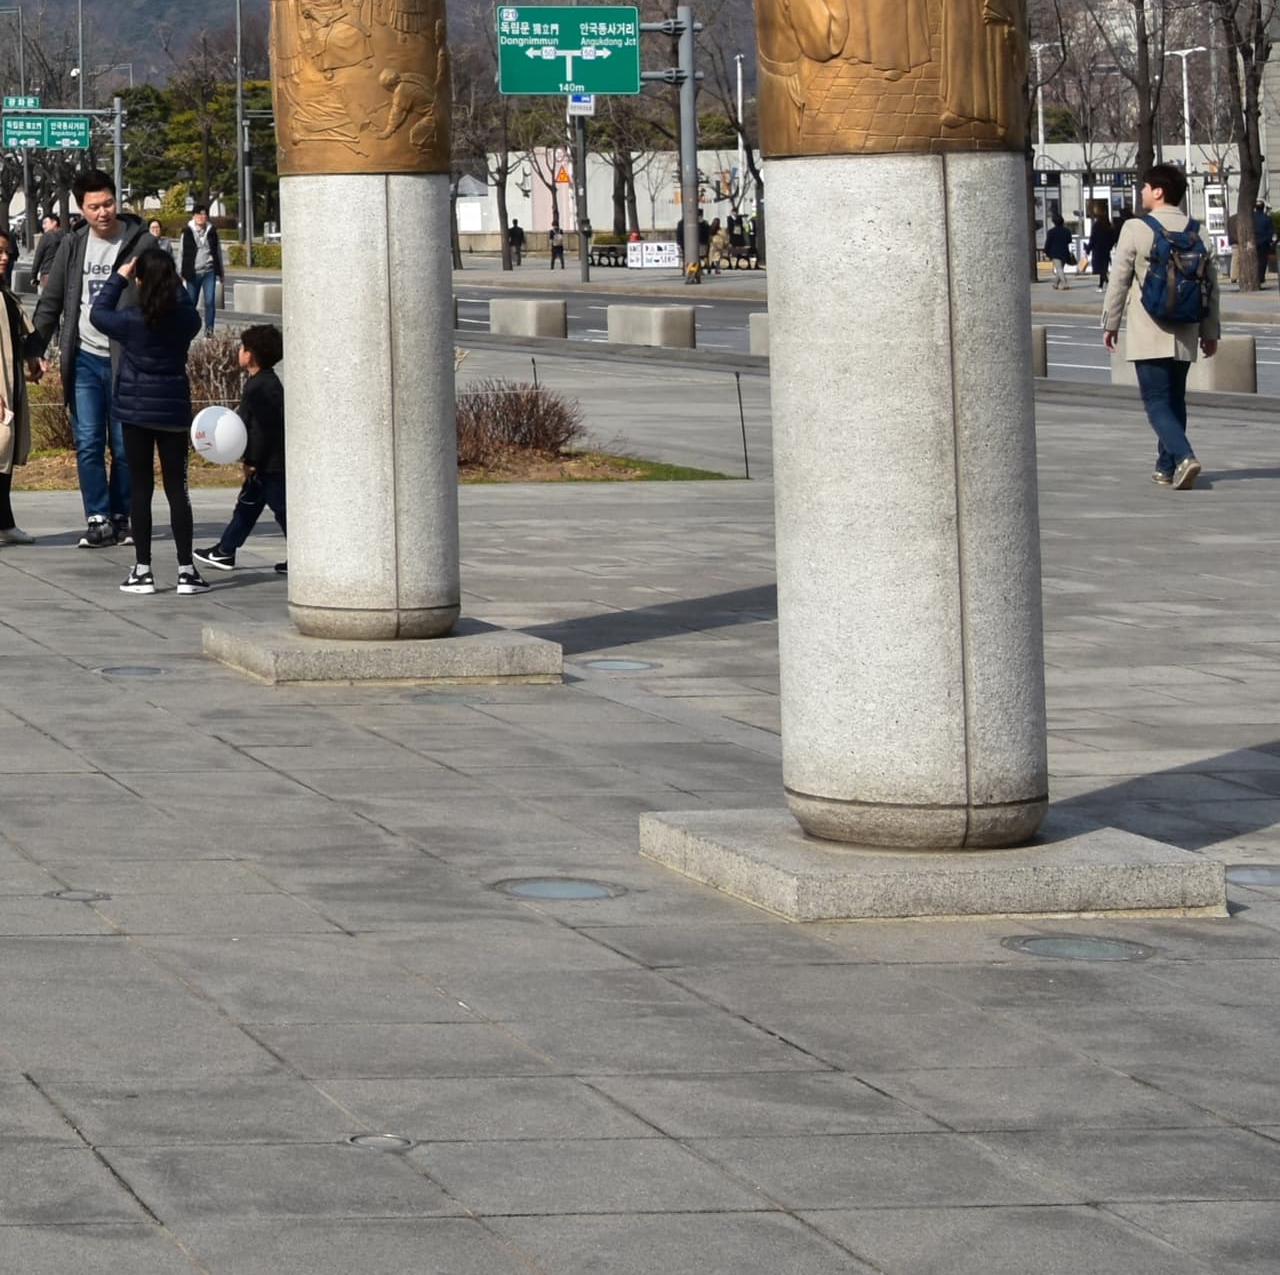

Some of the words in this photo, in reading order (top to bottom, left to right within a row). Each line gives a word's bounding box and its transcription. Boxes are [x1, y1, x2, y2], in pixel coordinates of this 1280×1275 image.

[500, 21, 530, 35] 독립문
[579, 22, 635, 35] 안국동사거리
[500, 36, 559, 47] Dongnimmun
[580, 37, 623, 48] Angukdong
[559, 83, 585, 92] 140m
[82, 261, 111, 275] Jee
